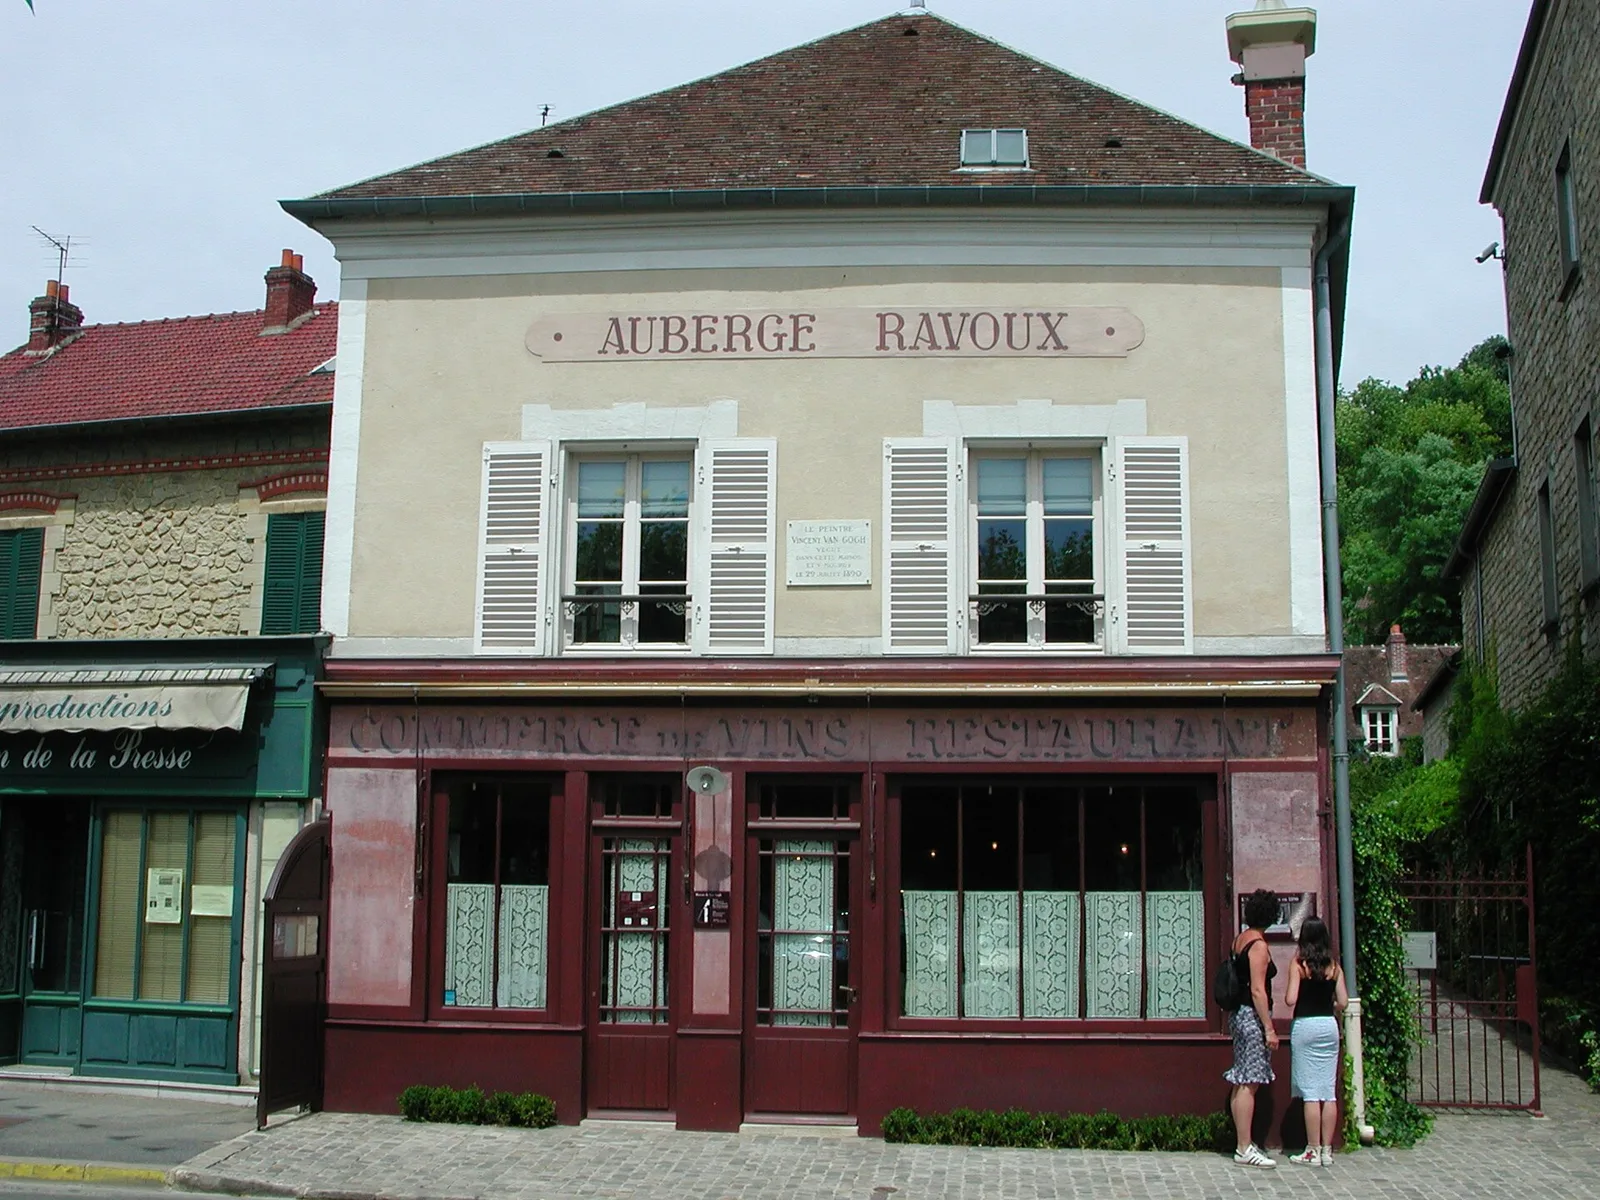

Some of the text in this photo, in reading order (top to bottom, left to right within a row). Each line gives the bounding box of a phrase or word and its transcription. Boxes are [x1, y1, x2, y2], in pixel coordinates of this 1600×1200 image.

[598, 311, 1069, 355] AUBERGE RAVOUX
[791, 535, 866, 544] VINCENT VAN GOGH
[818, 525, 853, 533] PEINTRE
[843, 569, 862, 577] 1890
[23, 736, 52, 769] de
[70, 736, 96, 769] la
[109, 730, 192, 770] Presse
[349, 713, 642, 755] COMMERCE
[717, 716, 854, 758] VINS
[905, 712, 1294, 759] RESTAURANT
